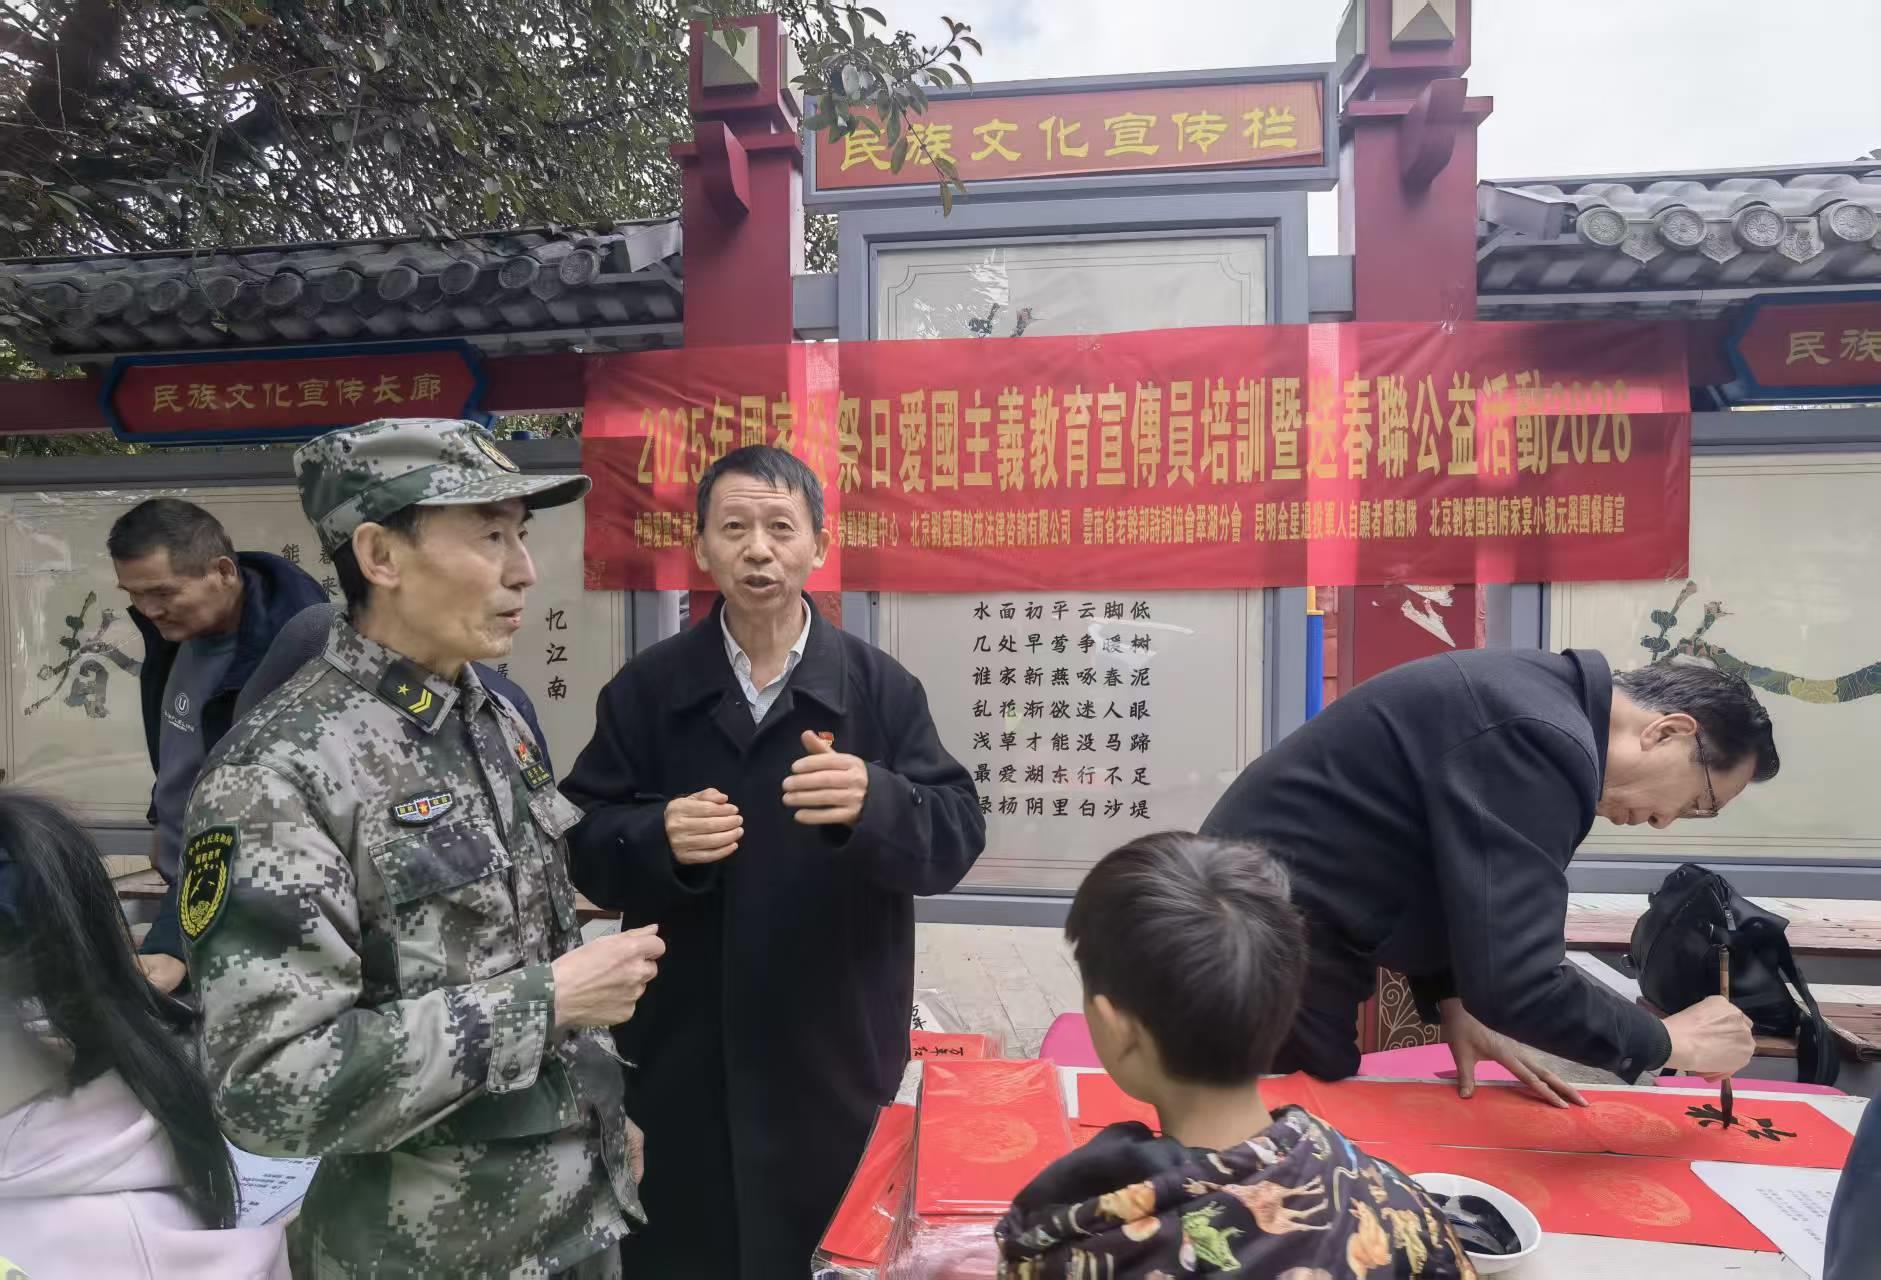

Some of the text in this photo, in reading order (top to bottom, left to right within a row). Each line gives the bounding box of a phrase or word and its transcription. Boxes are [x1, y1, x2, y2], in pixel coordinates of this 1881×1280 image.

[840, 106, 1298, 172] 民族文化宣传栏
[1785, 328, 1881, 365] 民族
[152, 373, 442, 413] 民族文化宣传长廊
[973, 600, 1151, 621] 水面初平云脚低
[545, 607, 568, 701] 忆江南
[972, 633, 1152, 654] 几处早莺争暖树
[972, 666, 1151, 688] 谁家新燕啄春泥
[972, 699, 1151, 720] 乱花渐欲迷人眼
[972, 731, 1151, 754] 浅草才能没马蹄
[973, 763, 1152, 786] 最爱湖东行不足
